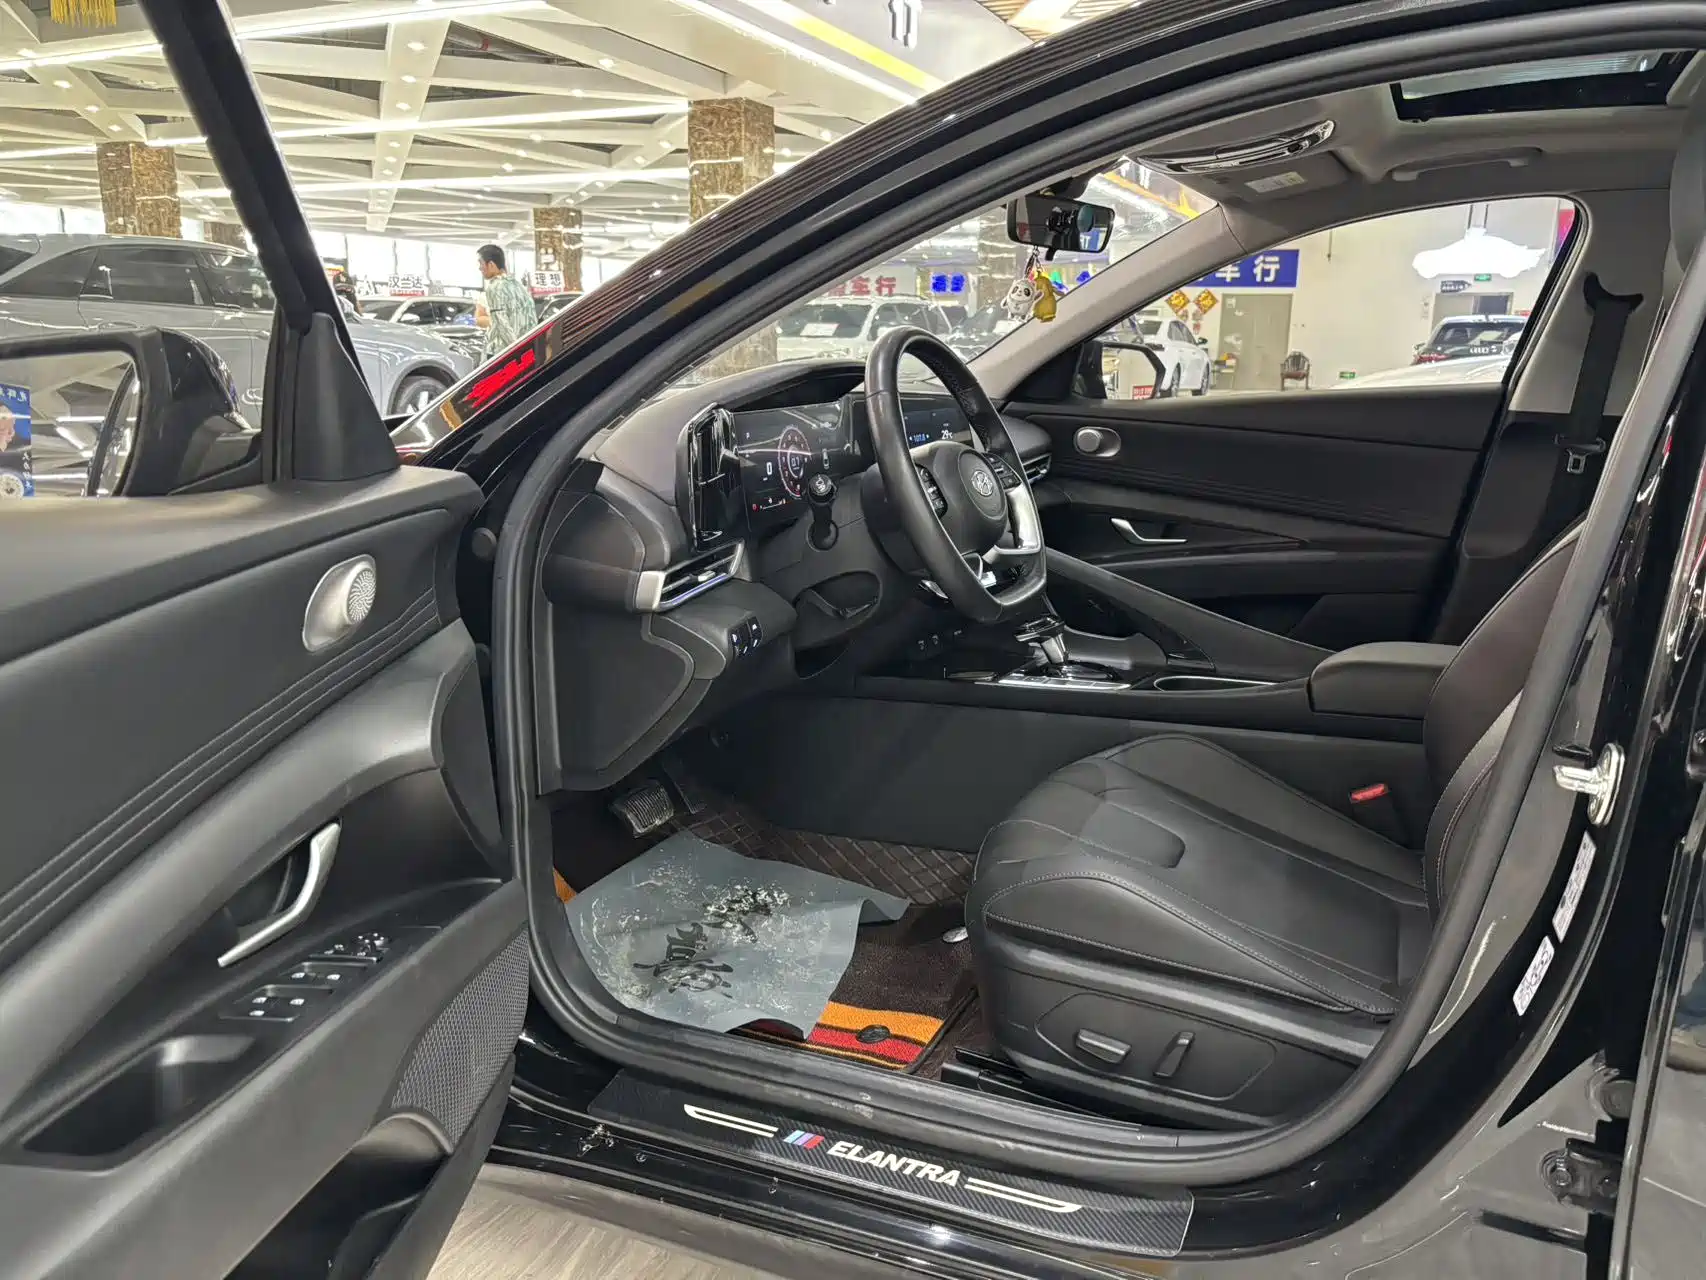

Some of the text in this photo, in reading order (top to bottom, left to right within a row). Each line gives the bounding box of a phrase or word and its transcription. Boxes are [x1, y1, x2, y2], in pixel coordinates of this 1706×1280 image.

[1199, 254, 1280, 282] 车行
[389, 276, 423, 289] 汉兰达
[534, 272, 561, 287] 理想
[826, 1140, 961, 1187] ELANTRA
